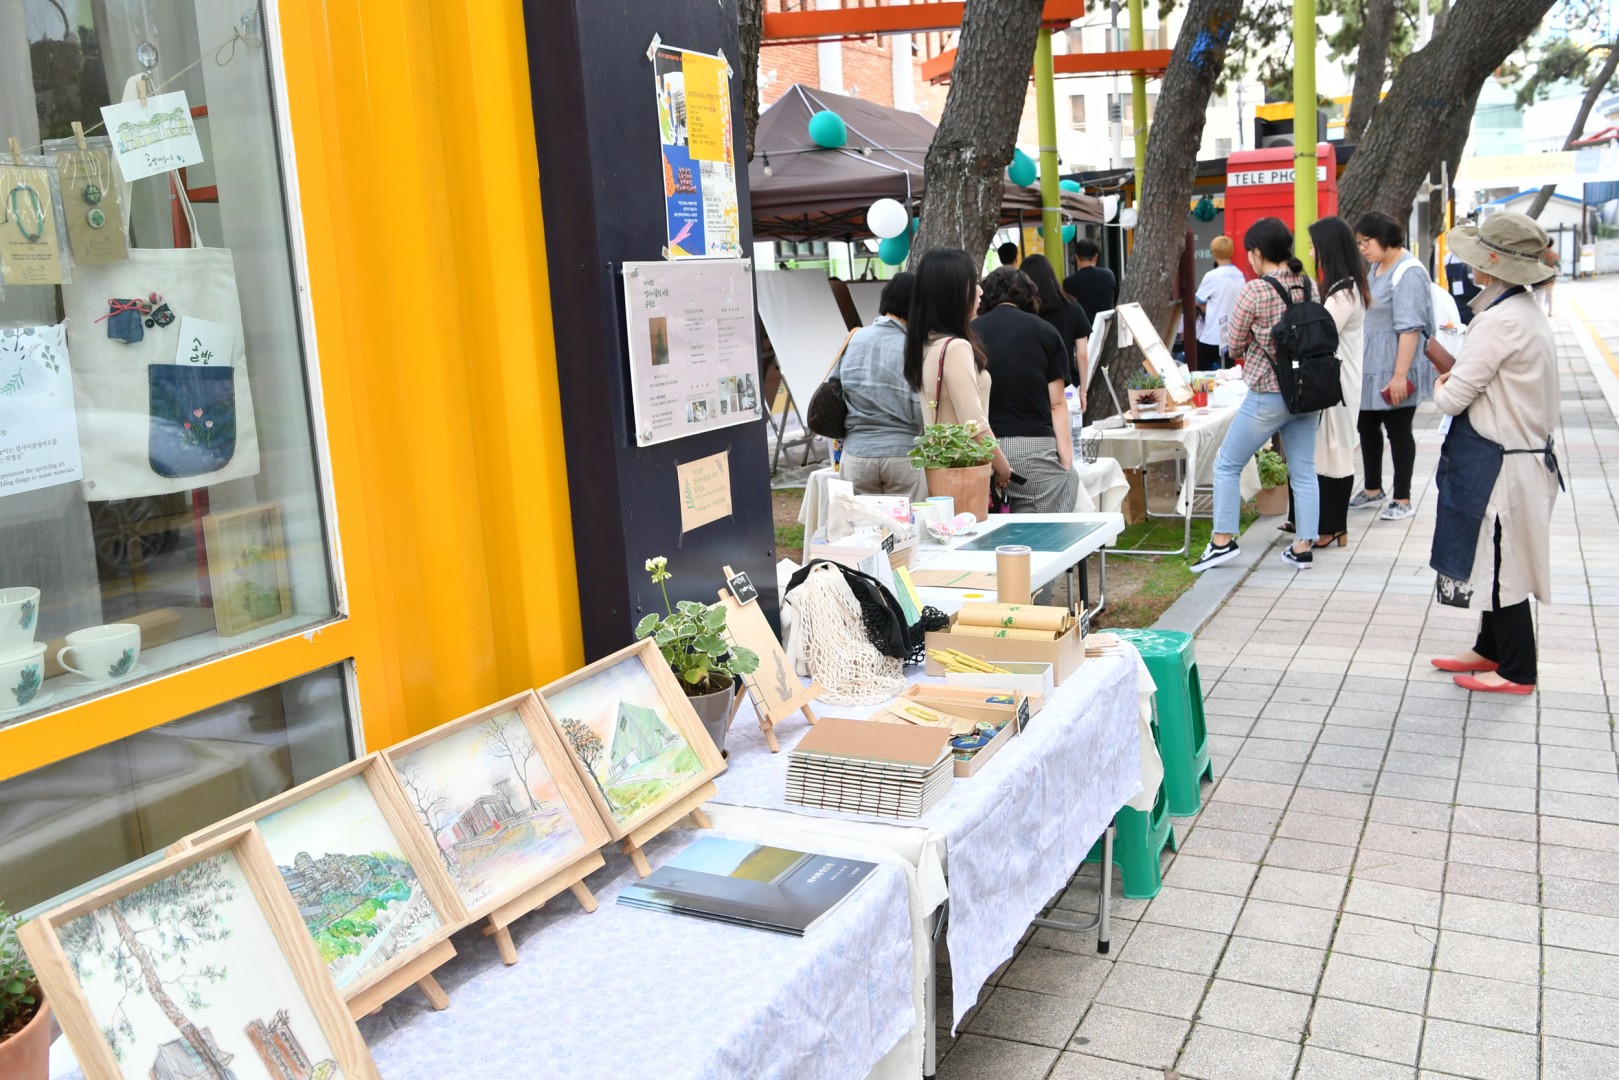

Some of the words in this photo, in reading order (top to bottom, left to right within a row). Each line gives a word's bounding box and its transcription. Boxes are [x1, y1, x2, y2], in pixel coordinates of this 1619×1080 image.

[1235, 172, 1265, 185] TELE
[1271, 168, 1320, 182] PHOE
[35, 463, 57, 472] upcycling
[15, 475, 31, 484] design
